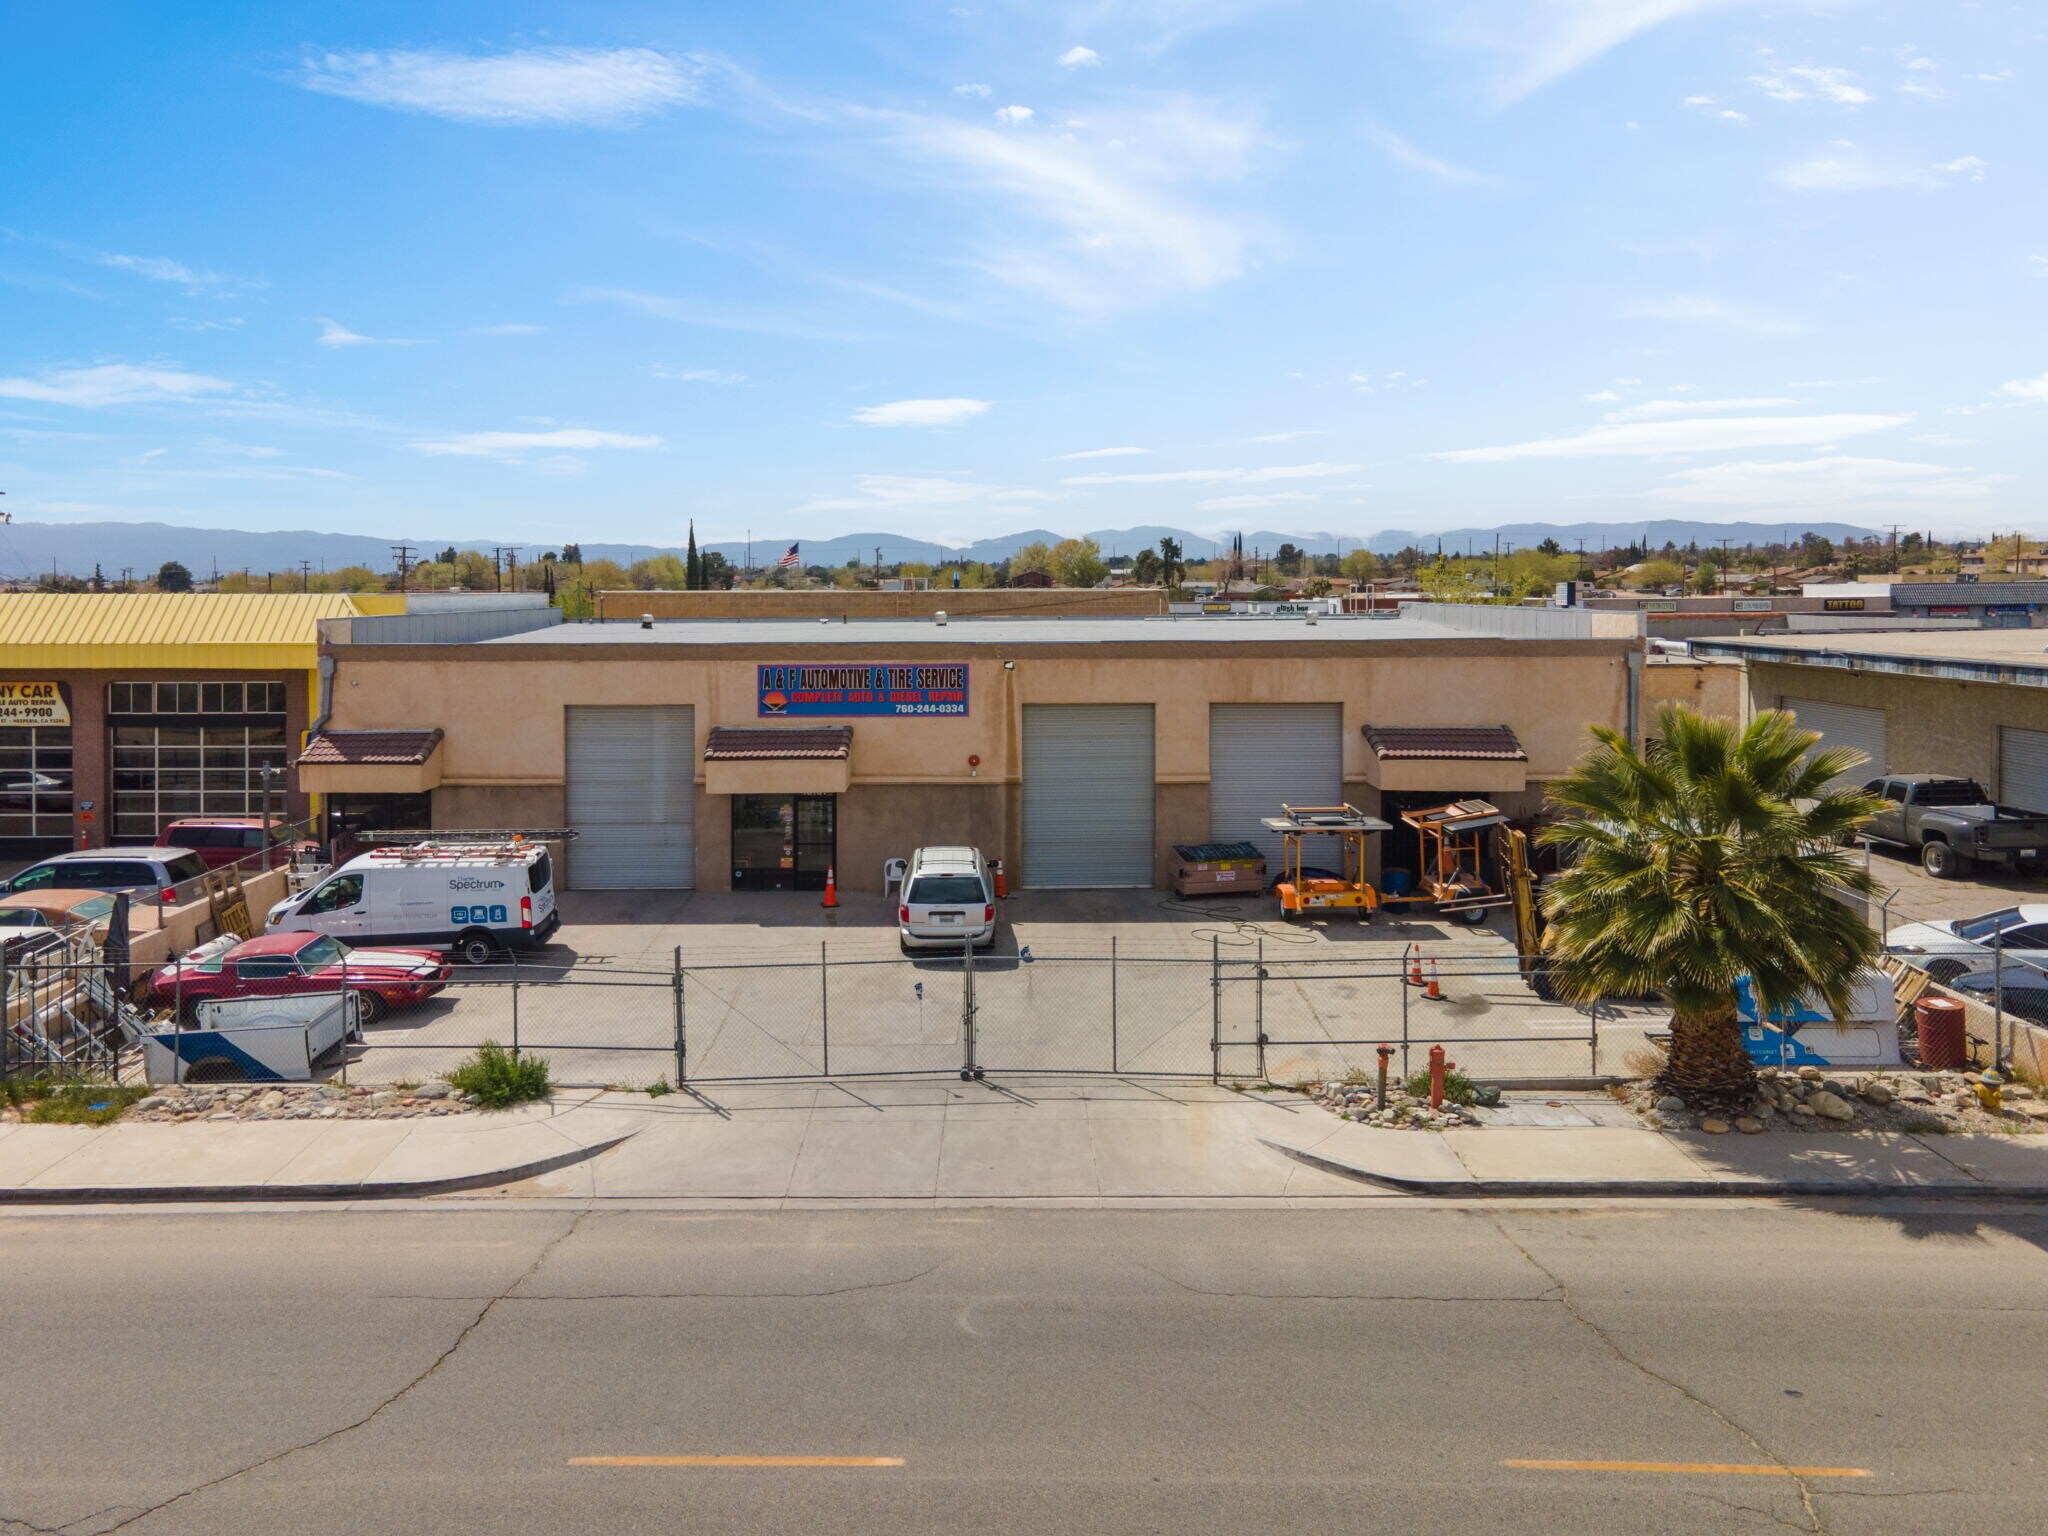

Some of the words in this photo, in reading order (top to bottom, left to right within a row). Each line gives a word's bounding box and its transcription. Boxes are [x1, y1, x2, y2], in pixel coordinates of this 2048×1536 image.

[1827, 600, 1864, 609] TATTOO
[763, 668, 771, 689] A
[775, 668, 786, 689] &
[788, 668, 796, 689] F
[799, 668, 871, 689] AUTOMOTIVE
[875, 668, 884, 689] &
[888, 668, 913, 689] TIRE
[916, 667, 964, 689] SERVICE
[21, 685, 53, 698] CAR
[790, 692, 843, 703] COMPLETE
[847, 692, 873, 703] AUTO
[889, 691, 922, 702] DIESEL
[928, 691, 963, 702] REPAIR
[895, 704, 964, 713] 760-244-0334
[449, 880, 501, 892] Spectrum
